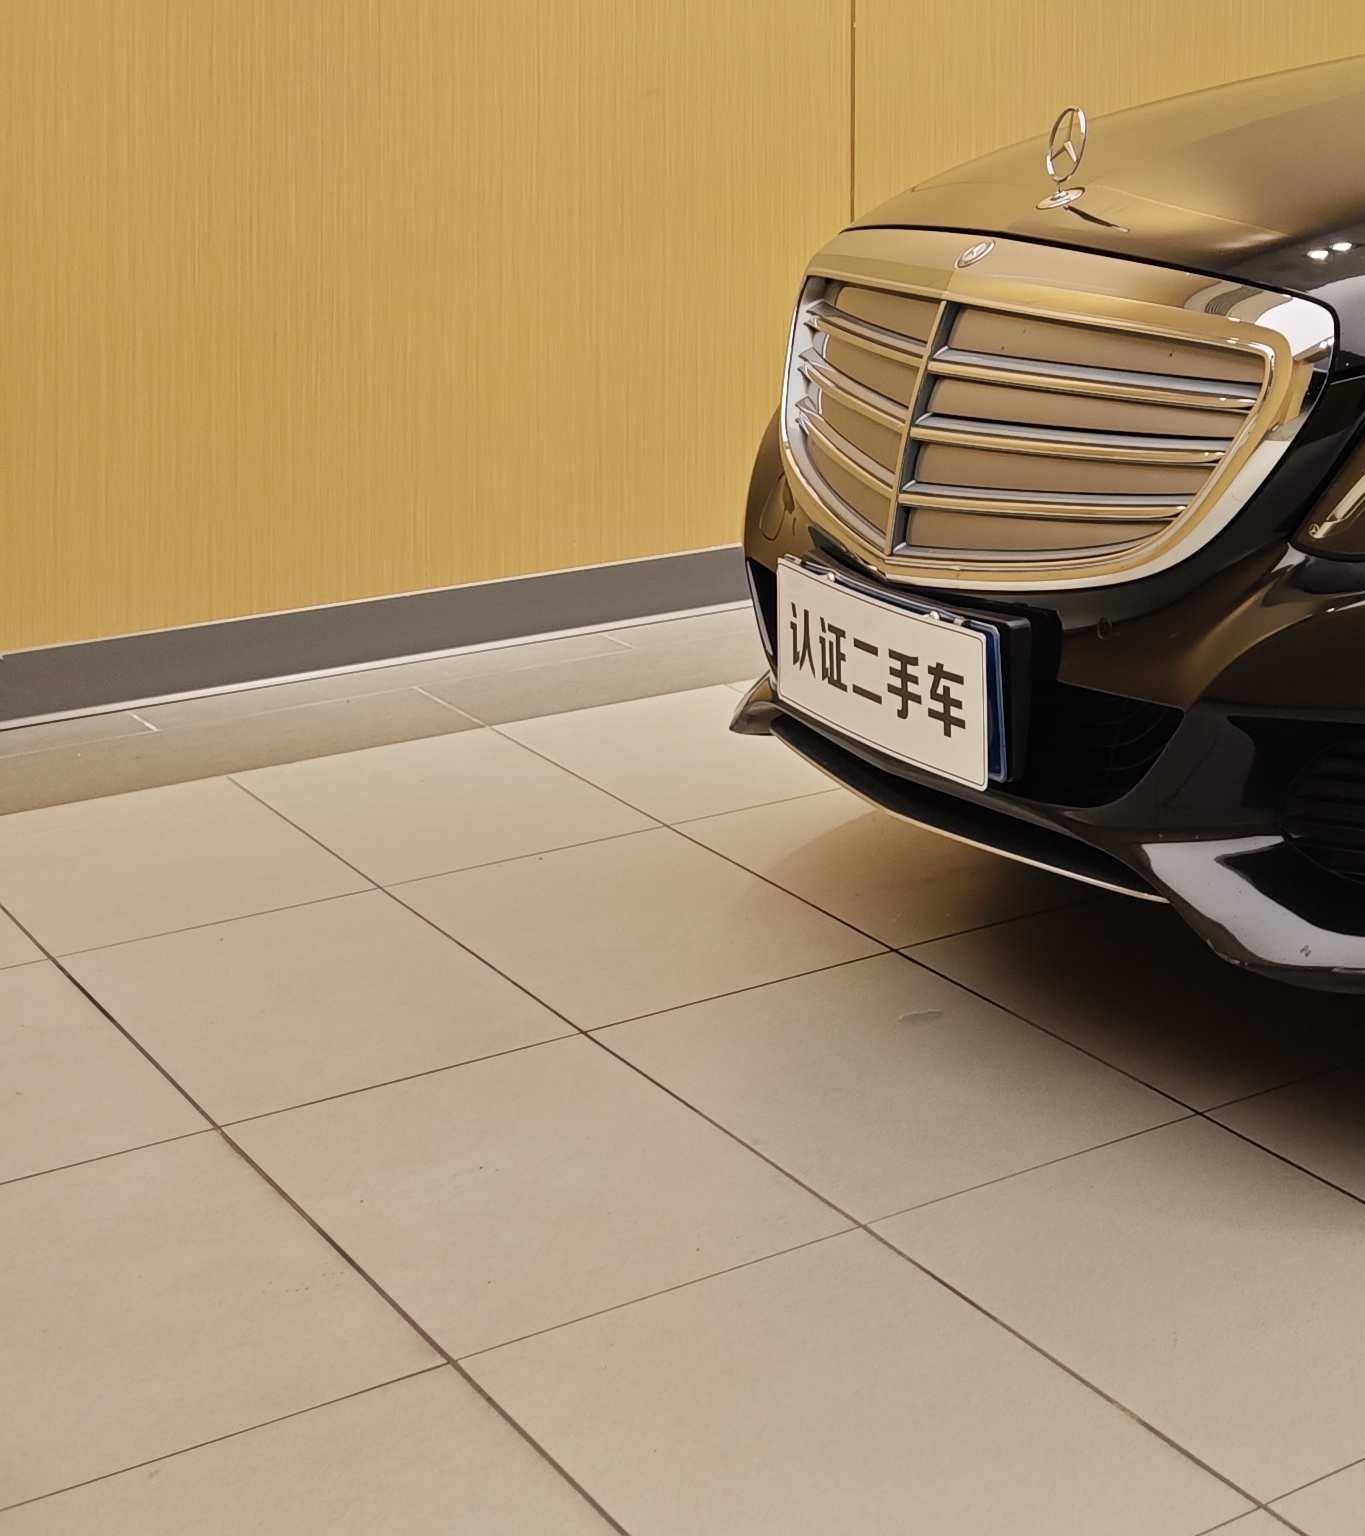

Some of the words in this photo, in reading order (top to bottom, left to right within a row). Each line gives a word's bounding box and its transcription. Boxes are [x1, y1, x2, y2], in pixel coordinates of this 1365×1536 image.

[789, 601, 967, 738] 认证二手车
